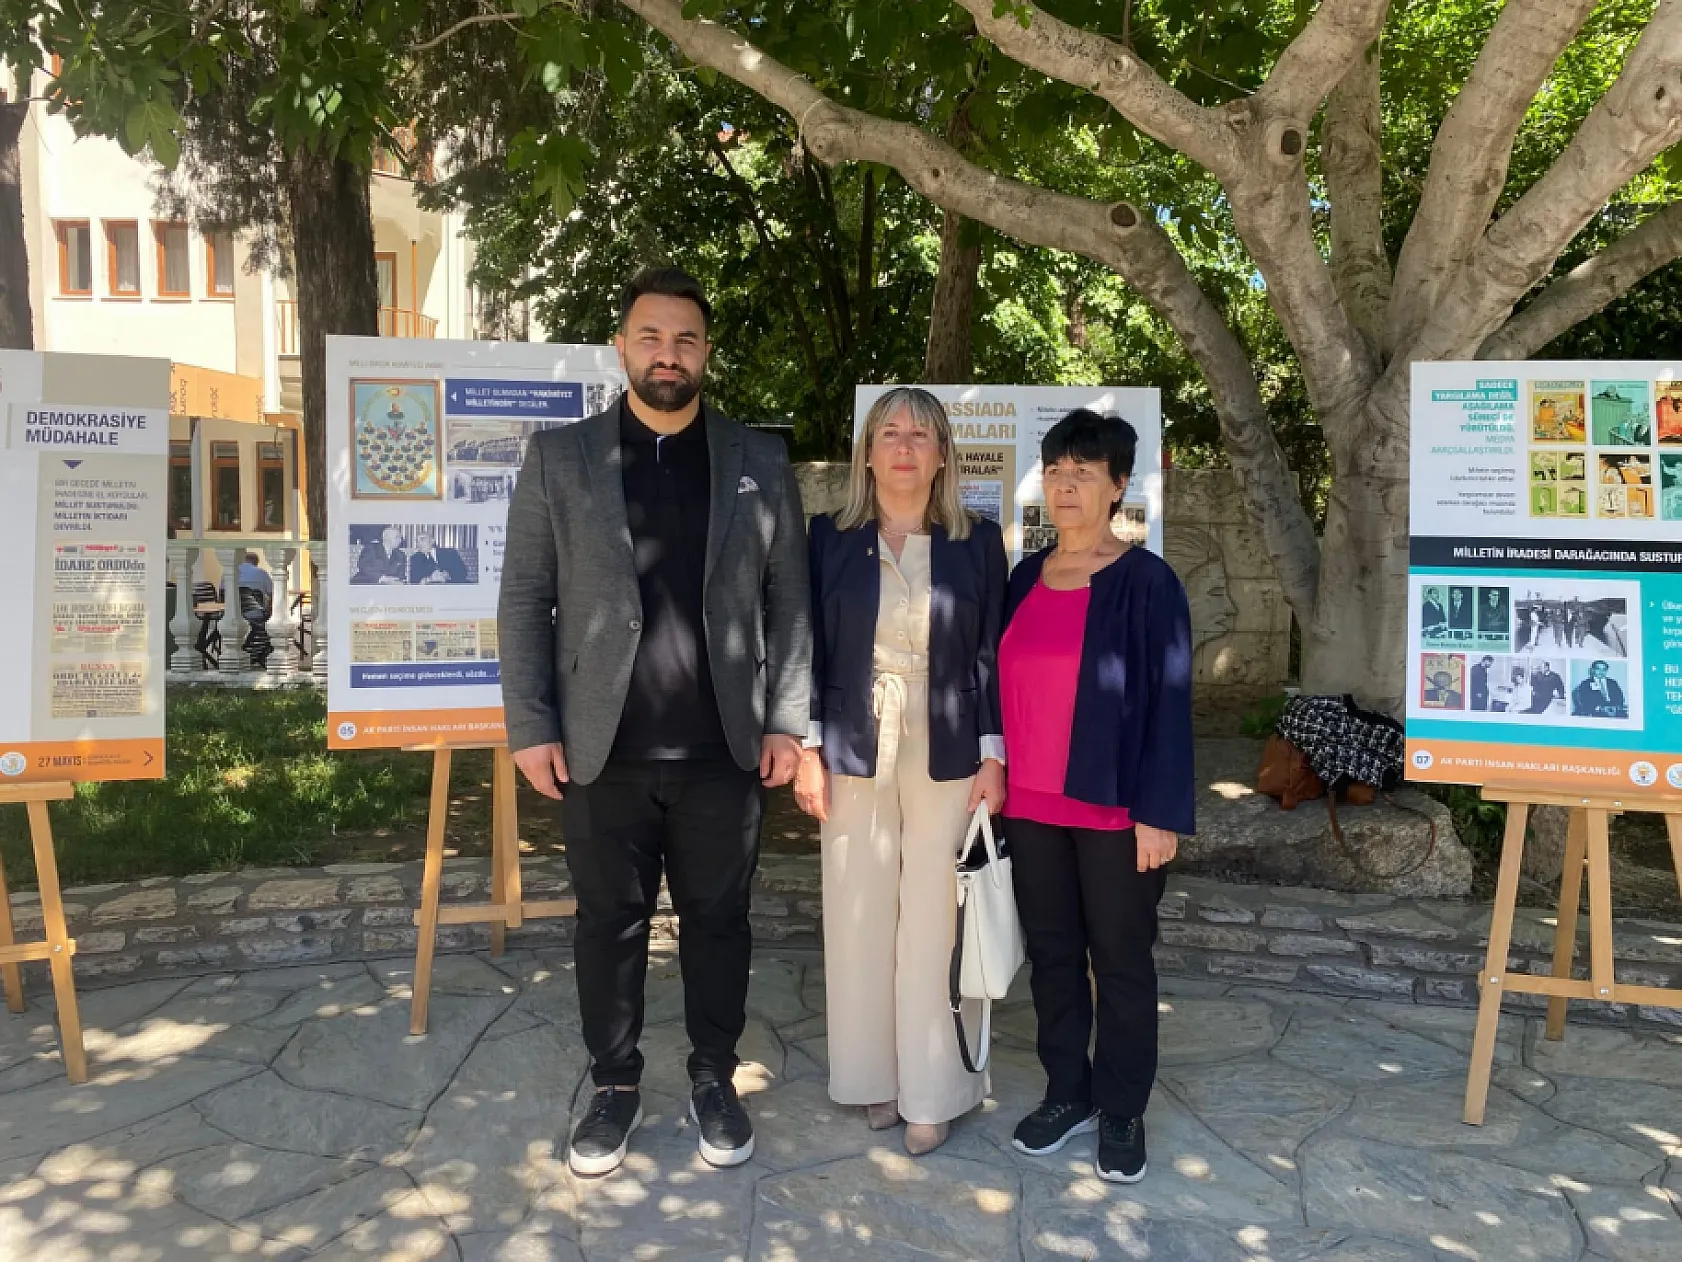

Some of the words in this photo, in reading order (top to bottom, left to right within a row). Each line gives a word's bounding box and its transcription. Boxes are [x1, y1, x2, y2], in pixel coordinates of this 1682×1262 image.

[944, 402, 1016, 416] ASSIADA
[26, 411, 147, 429] DEMOKRASİYE
[25, 427, 119, 445] MÜDAHALE
[951, 424, 1016, 438] MALARI
[965, 452, 1004, 463] HAYALE
[1453, 546, 1504, 558] MİLLETİN
[1506, 546, 1551, 560] İRADESİ
[1554, 548, 1637, 561] DARAĞACINDA
[38, 756, 51, 768] 27
[1416, 755, 1430, 764] 07
[1440, 757, 1453, 766] AK
[1516, 760, 1559, 772] HAKLARI
